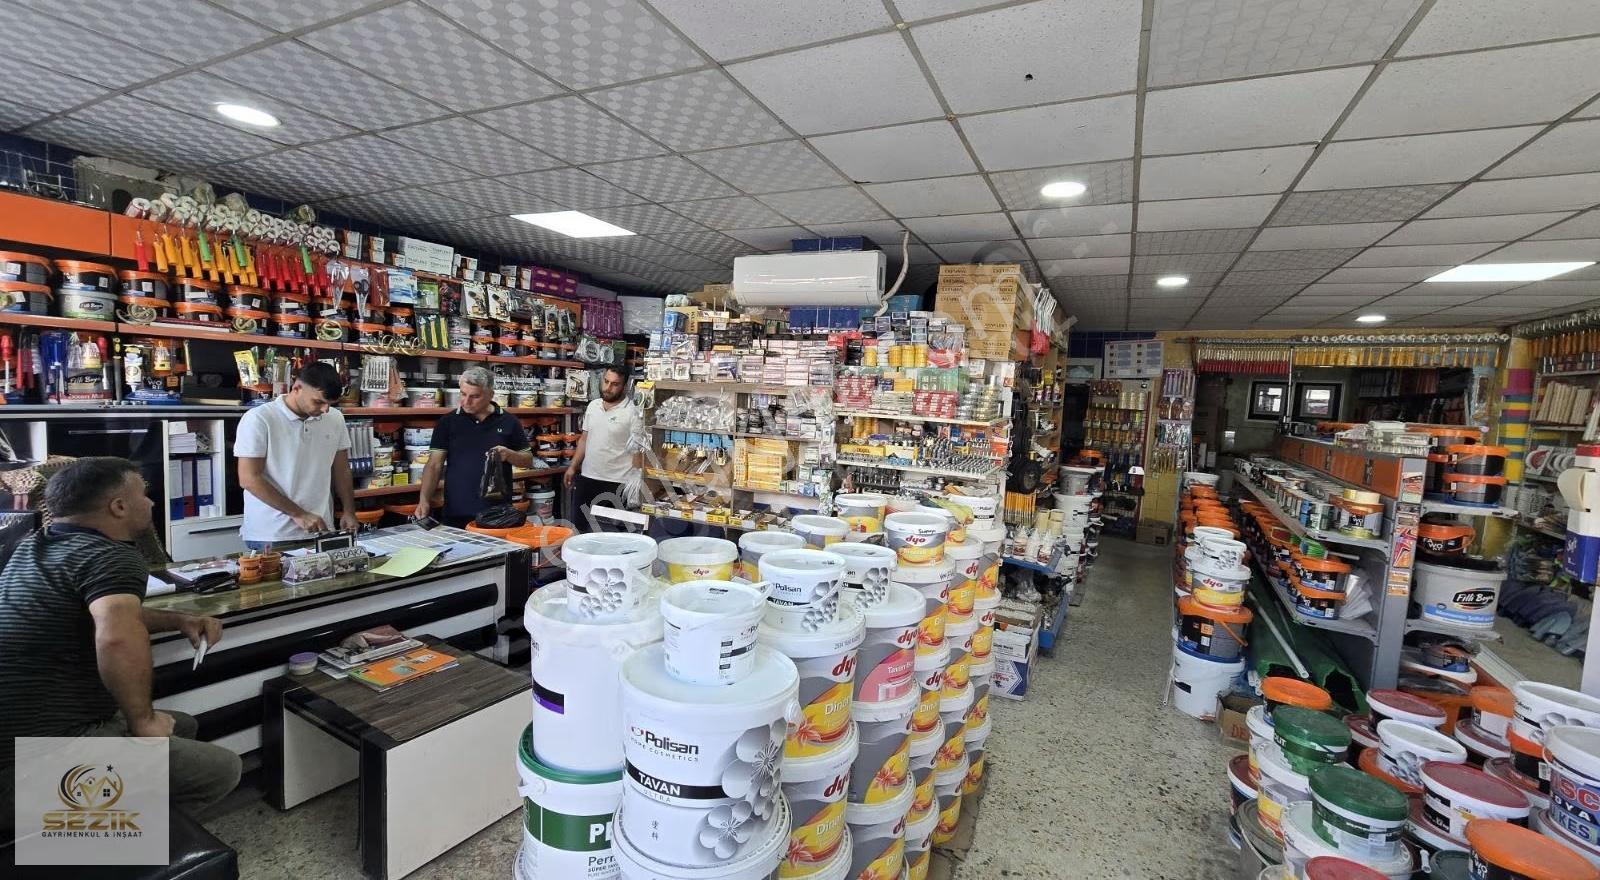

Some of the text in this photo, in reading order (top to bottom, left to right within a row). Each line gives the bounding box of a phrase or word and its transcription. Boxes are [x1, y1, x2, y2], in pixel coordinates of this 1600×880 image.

[905, 535, 926, 545] dyo
[693, 568, 709, 576] dyo
[965, 562, 979, 575] dy
[775, 583, 802, 593] Polisan
[1202, 578, 1224, 588] dyo
[1456, 592, 1475, 602] Filli
[645, 730, 700, 755] Polisan
[649, 746, 699, 762] COSMETICS
[638, 772, 681, 796] TAVAN
